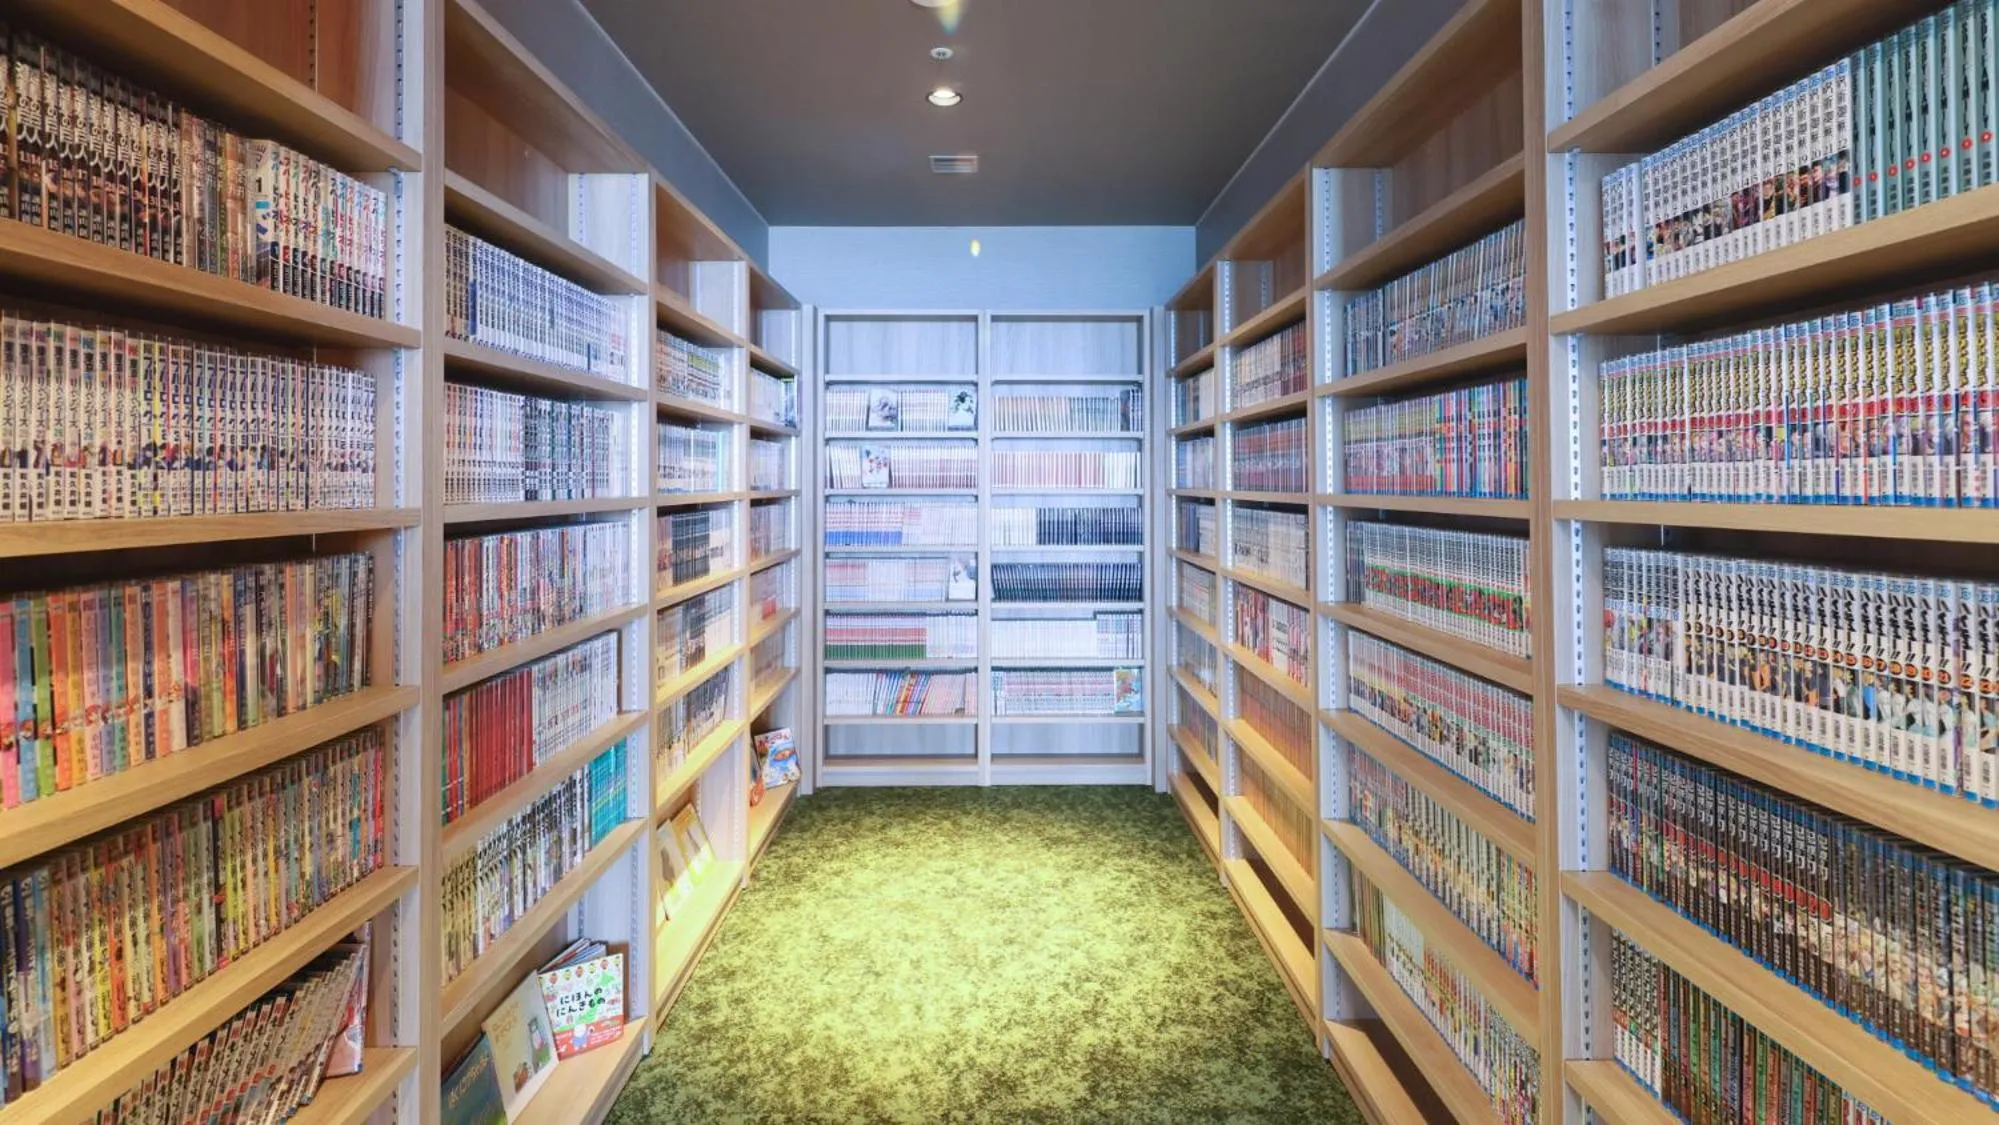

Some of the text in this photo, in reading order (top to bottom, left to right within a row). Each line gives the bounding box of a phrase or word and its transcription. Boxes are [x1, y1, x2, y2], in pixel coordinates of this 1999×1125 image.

[560, 988, 602, 1005] にほんの
[557, 997, 605, 1017] にんきもの
